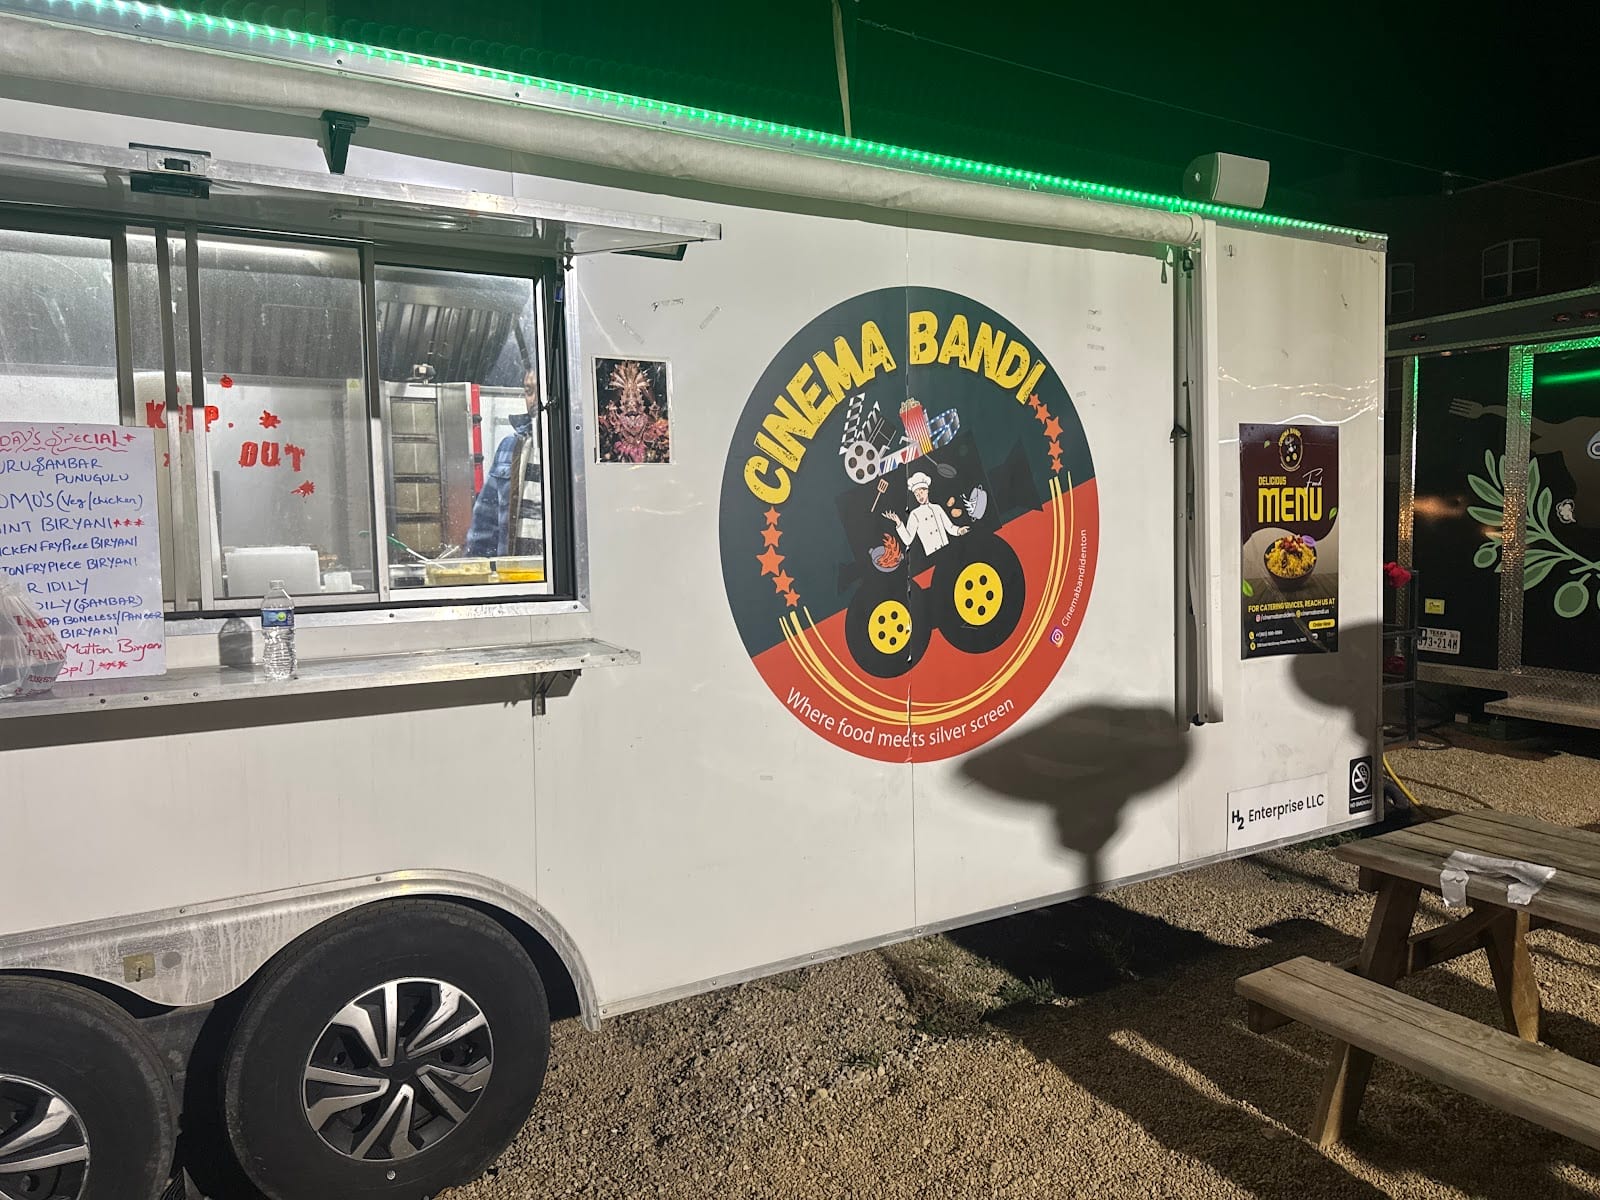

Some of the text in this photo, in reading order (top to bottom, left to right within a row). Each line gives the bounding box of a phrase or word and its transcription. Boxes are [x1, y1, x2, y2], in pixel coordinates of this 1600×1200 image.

[743, 310, 1047, 504] CINEMA BANDI
[238, 440, 306, 472] OUT
[55, 473, 129, 485] PUNUGULU
[1258, 467, 1324, 495] DELICIOUS Food
[1258, 487, 1323, 523] MENU
[41, 516, 113, 532] BIRYANI
[91, 536, 137, 549] BIRYANI
[87, 557, 137, 570] BIRYANI
[1061, 529, 1088, 627] Cinemabandidenton
[1248, 605, 1259, 613] FOR
[60, 626, 118, 639] BIRYANI
[63, 642, 113, 655] Mutton
[786, 686, 1016, 748] Where food meets silver screen
[1248, 799, 1304, 822] Enterprise
[1306, 793, 1325, 810] LLC
